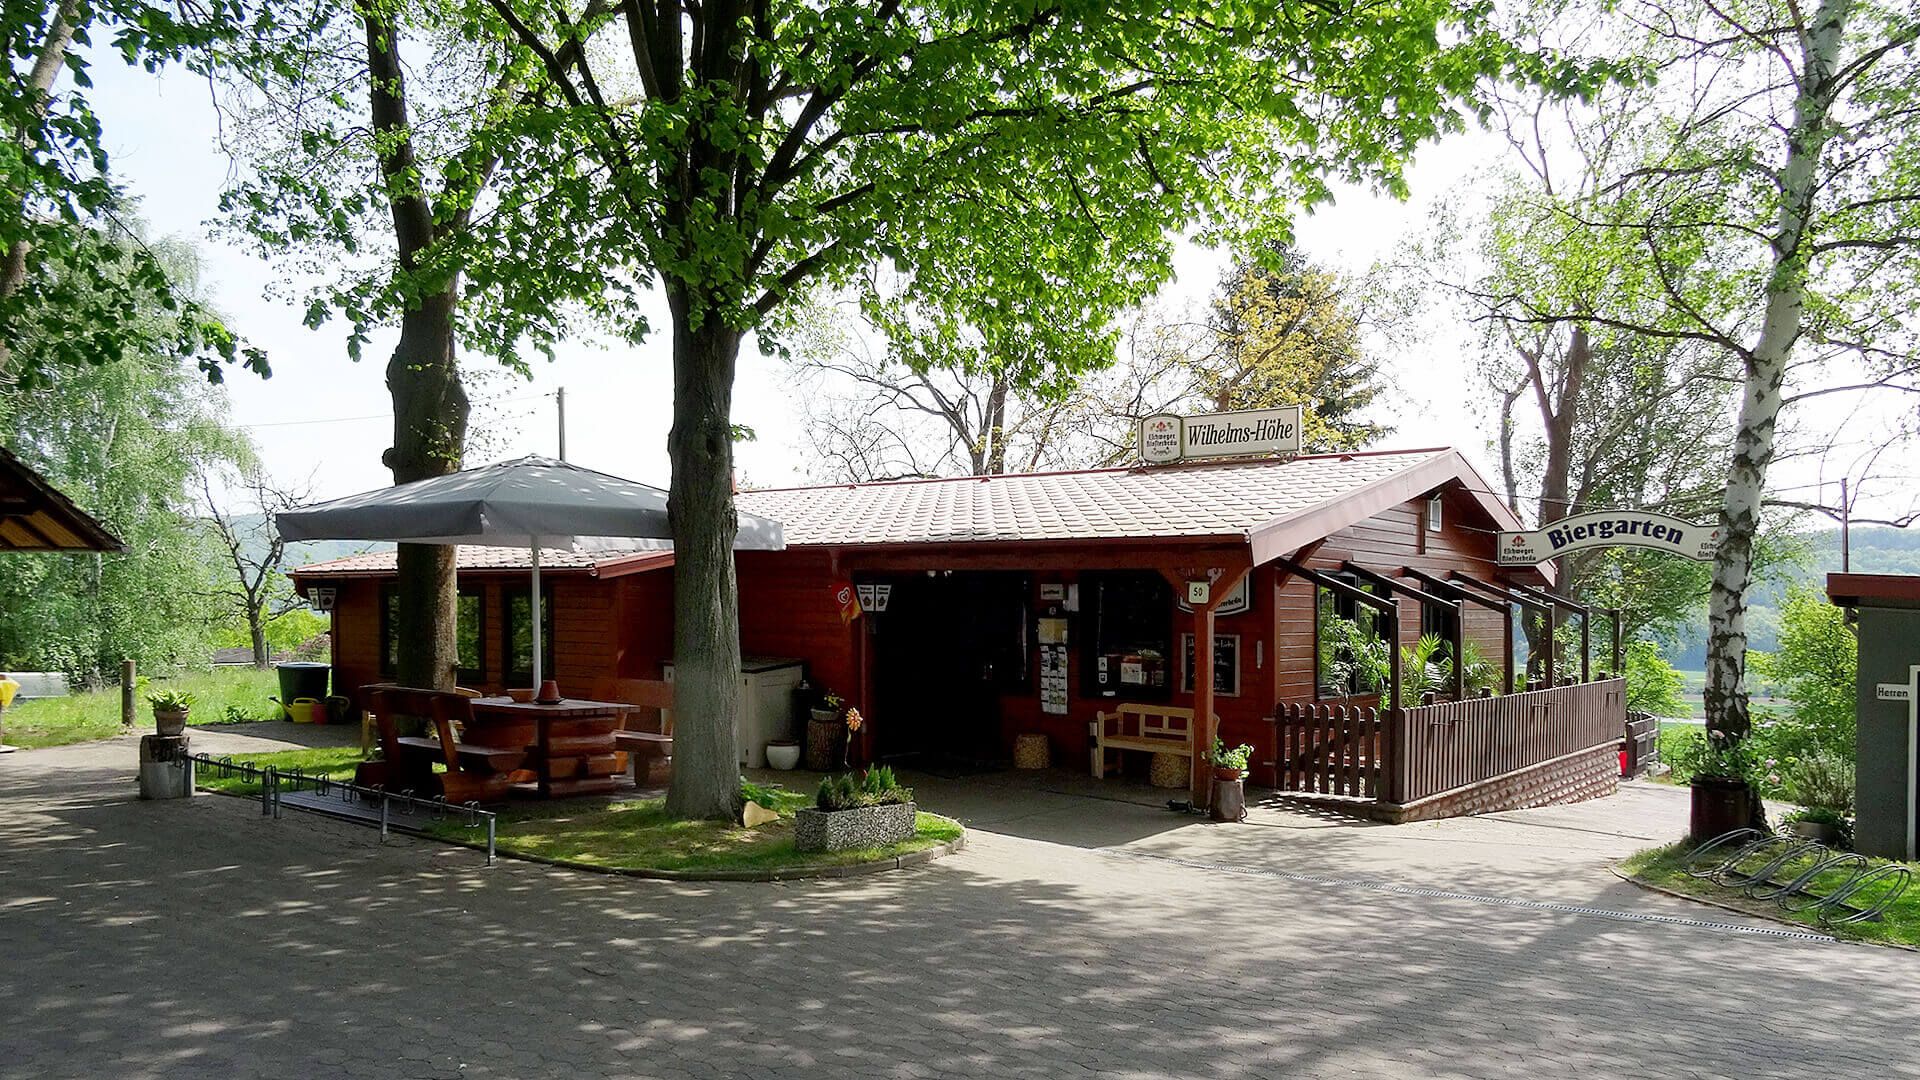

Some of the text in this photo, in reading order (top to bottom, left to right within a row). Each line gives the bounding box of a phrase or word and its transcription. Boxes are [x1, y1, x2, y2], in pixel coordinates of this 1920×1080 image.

[1188, 418, 1293, 446] Wilhelms-Höhe
[1547, 519, 1684, 550] Biergarten
[1193, 587, 1203, 597] 50
[1877, 687, 1909, 697] Herren
